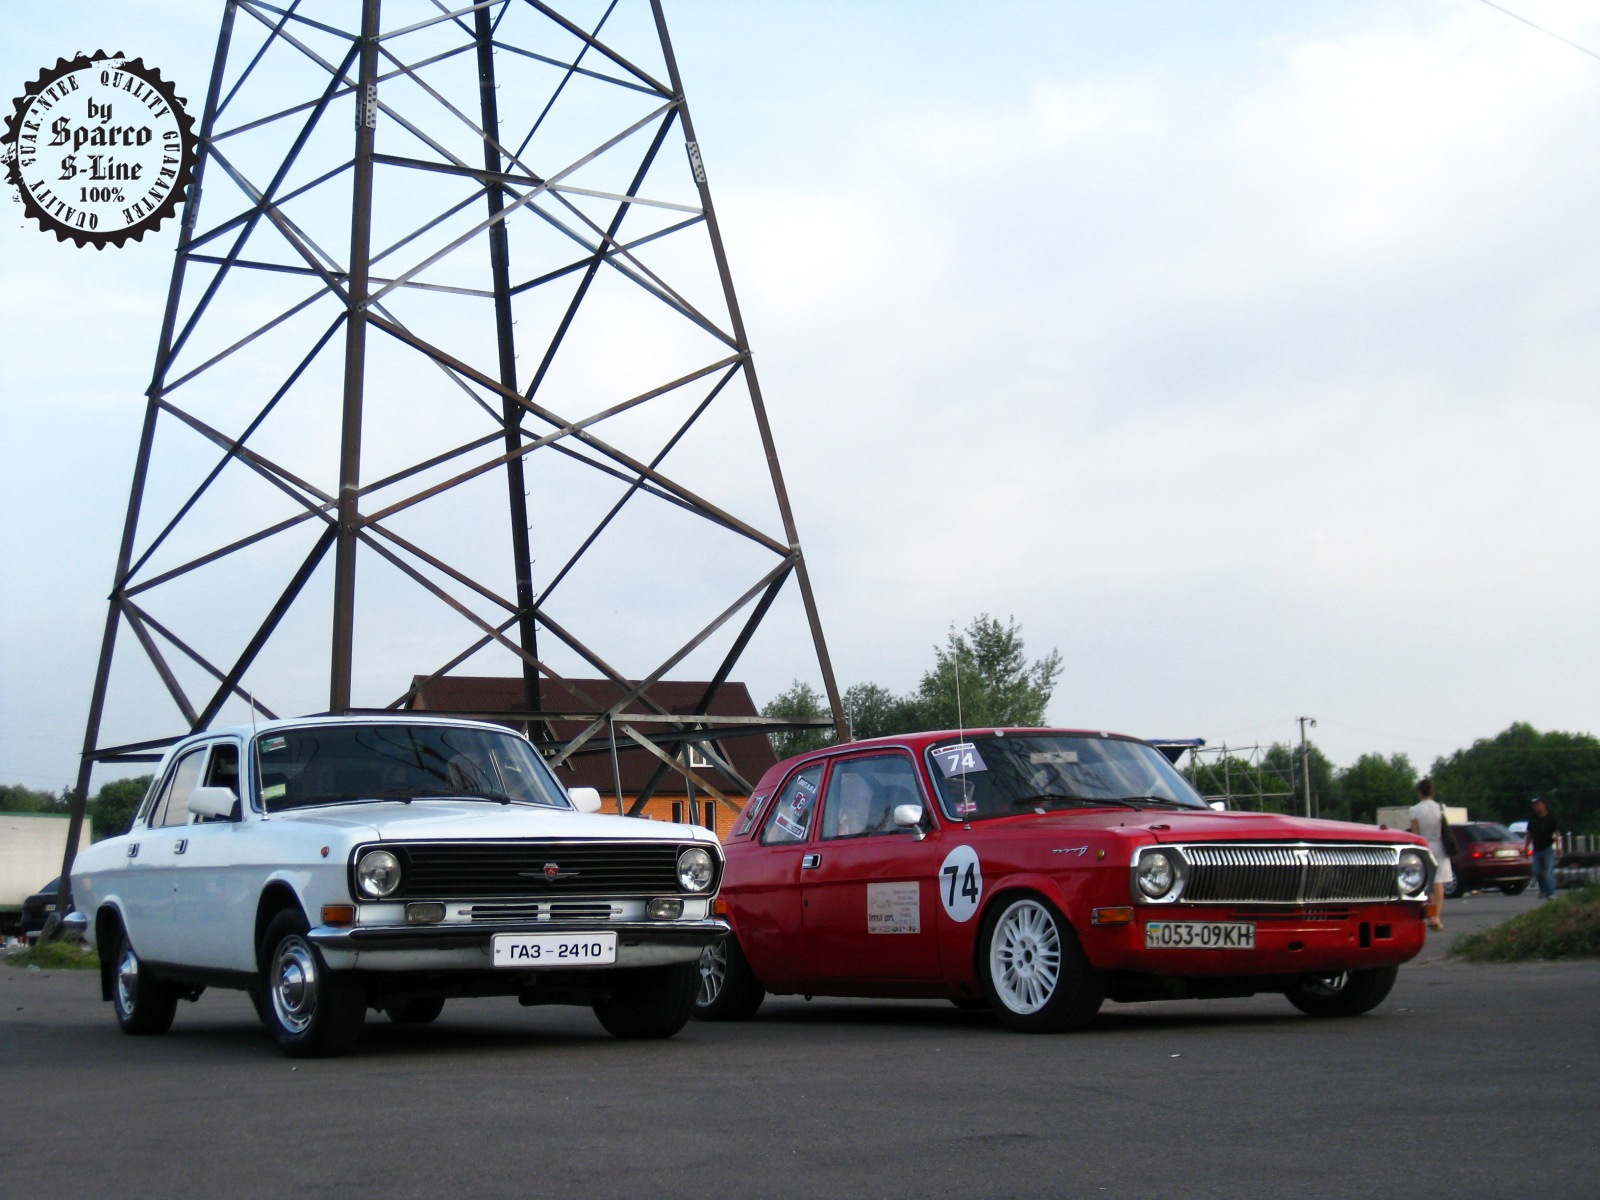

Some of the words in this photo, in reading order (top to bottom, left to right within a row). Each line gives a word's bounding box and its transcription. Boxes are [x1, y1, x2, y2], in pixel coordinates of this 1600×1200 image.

[947, 752, 975, 772] 74
[943, 862, 978, 906] 74
[510, 944, 541, 959] ГАЗ
[558, 943, 602, 957] 2410
